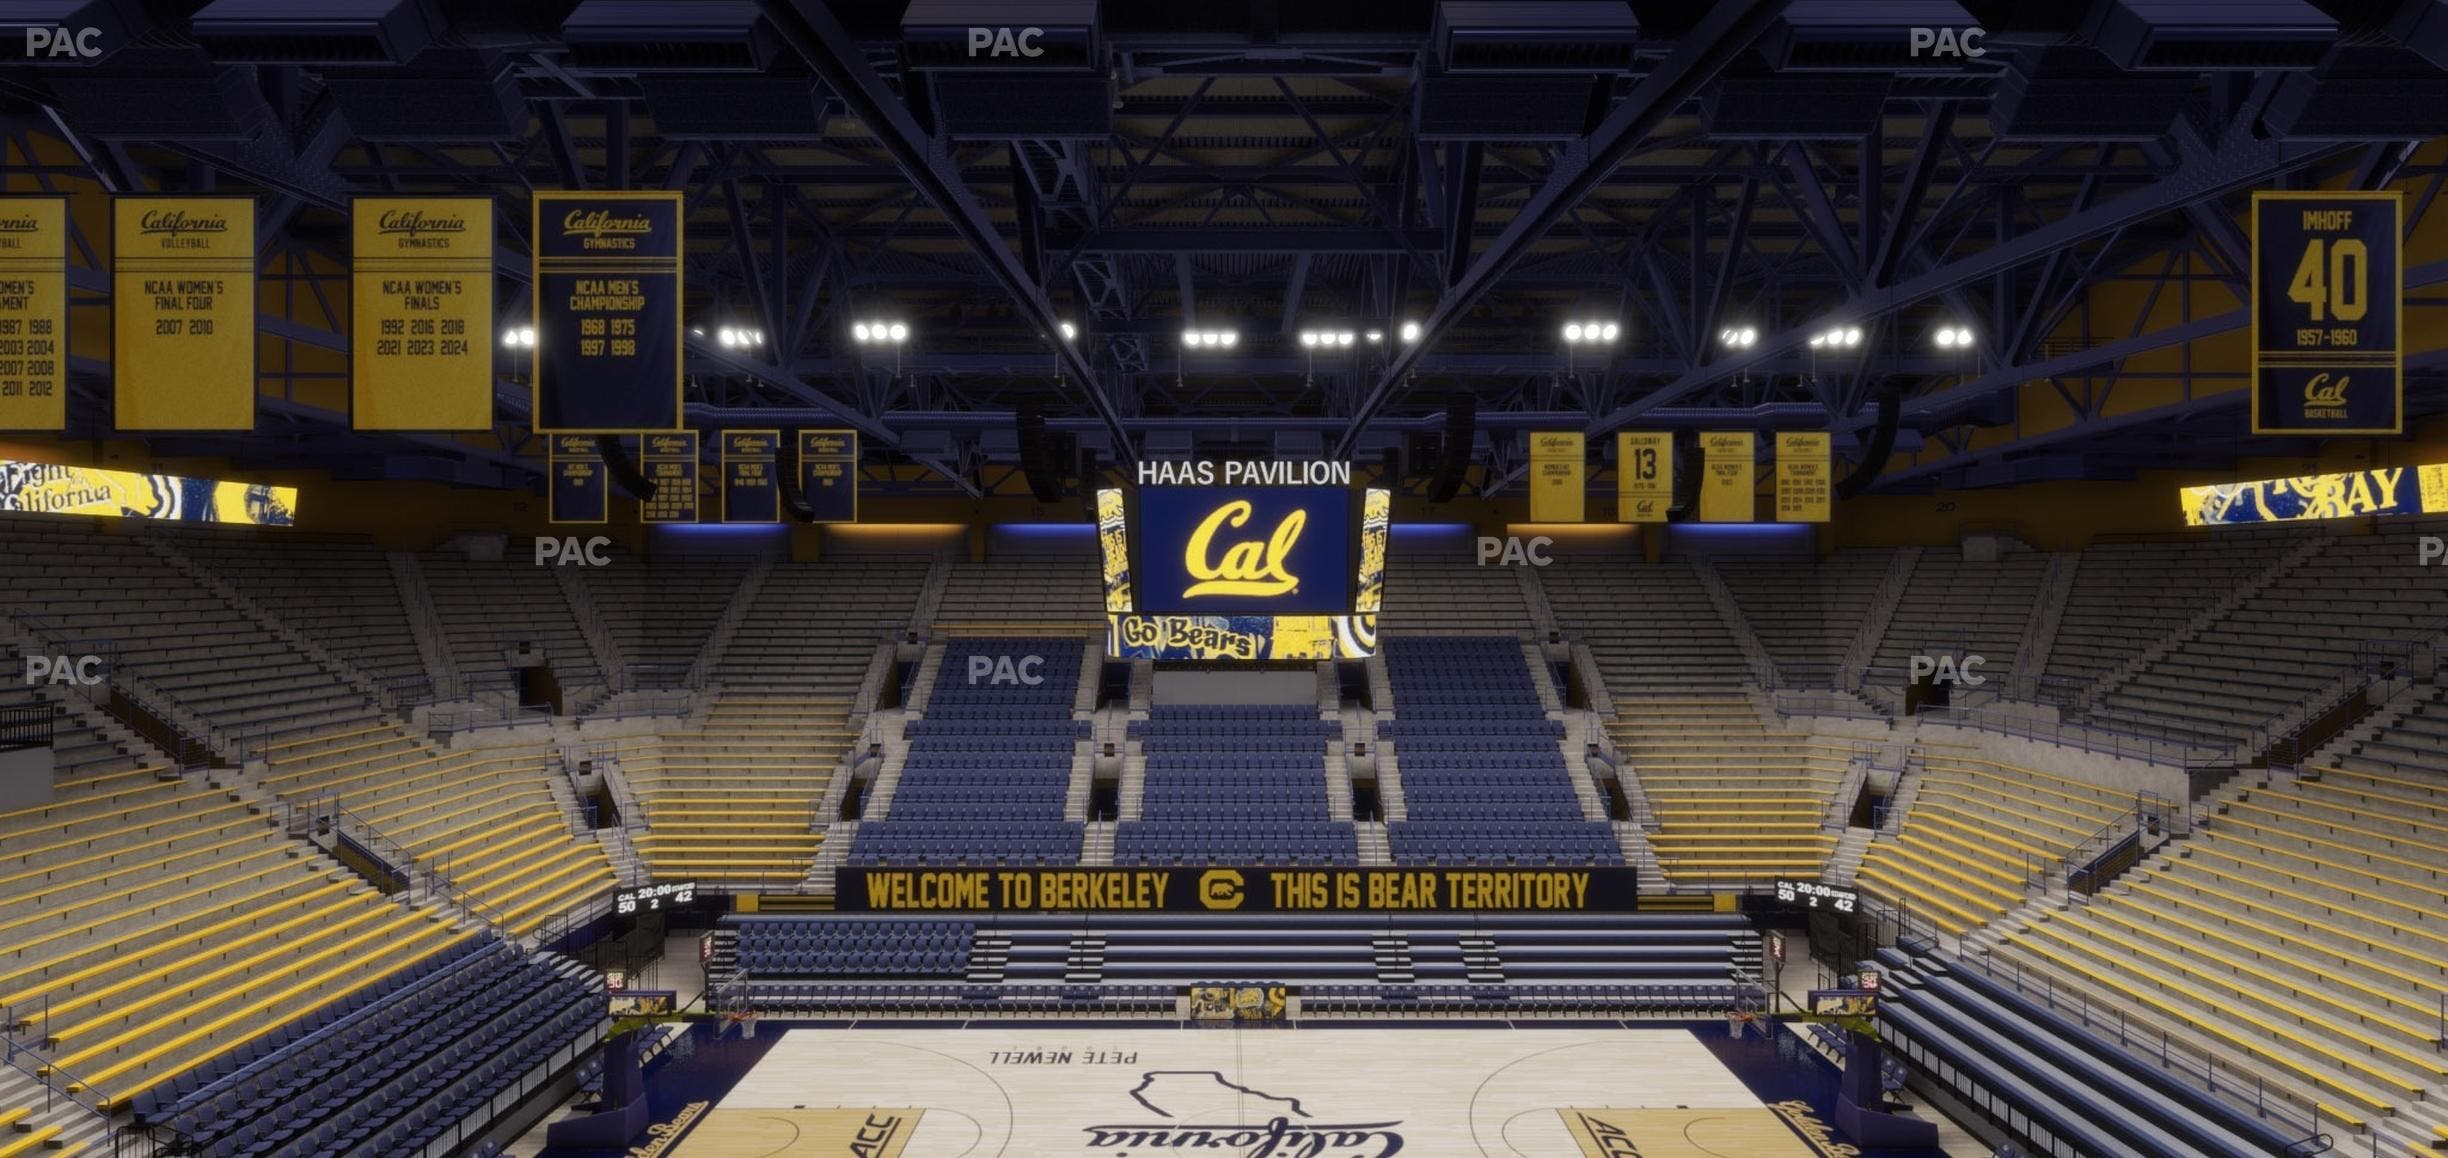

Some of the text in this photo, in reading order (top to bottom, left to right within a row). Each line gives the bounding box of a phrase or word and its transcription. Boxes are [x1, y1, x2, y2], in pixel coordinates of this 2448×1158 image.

[140, 210, 228, 237] California
[378, 210, 466, 237] California
[563, 209, 653, 238] California
[2302, 210, 2352, 231] IMHOFF
[161, 238, 211, 249] VOLLEYBALL
[398, 238, 450, 249] GYMNASTICS
[583, 237, 635, 249] GYMNASTICS
[144, 281, 224, 295] NCAA WOMEN'S
[382, 280, 462, 294] NCAA WOMEN'S
[575, 280, 639, 295] NCAA MEN'S
[2287, 238, 2368, 322] 40
[155, 297, 213, 311] FINAL FOUR
[404, 296, 440, 310] FINALS
[570, 296, 646, 311] CHAMPIONSHIP
[29, 319, 52, 335] 1988
[156, 319, 214, 335] 2007 2010
[381, 319, 465, 335] 1992 2016 2018
[581, 318, 636, 335] 1968 1975
[2296, 329, 2357, 346] 1957-1960
[27, 340, 54, 355] 2004
[377, 340, 468, 355] 2021 2023 2024
[581, 339, 636, 356] 1997 1998
[27, 360, 54, 376] 2008
[2, 381, 53, 396] 2011 2012
[2303, 372, 2350, 407] Cal
[2303, 408, 2348, 419] BASKETBALL
[1138, 460, 1351, 485] HAAS PAVILION
[1634, 448, 1657, 480] 13
[1182, 500, 1307, 599] Cal
[1123, 617, 1251, 657] Go Bears
[617, 892, 636, 902] CAL
[638, 884, 671, 899] 20:00
[866, 872, 1170, 909] WELCOME TO BERKELEY
[1271, 872, 1590, 909] THIS IS BEAR TERRITORY
[1777, 881, 1796, 891] CAL
[1796, 882, 1830, 898] 20:00
[618, 890, 693, 914] 50 2 42
[1778, 889, 1854, 912] 50 2 42
[988, 1051, 1138, 1065] PETE NEWELL
[850, 1113, 895, 1158] ACC
[1083, 1117, 1404, 1158] California
